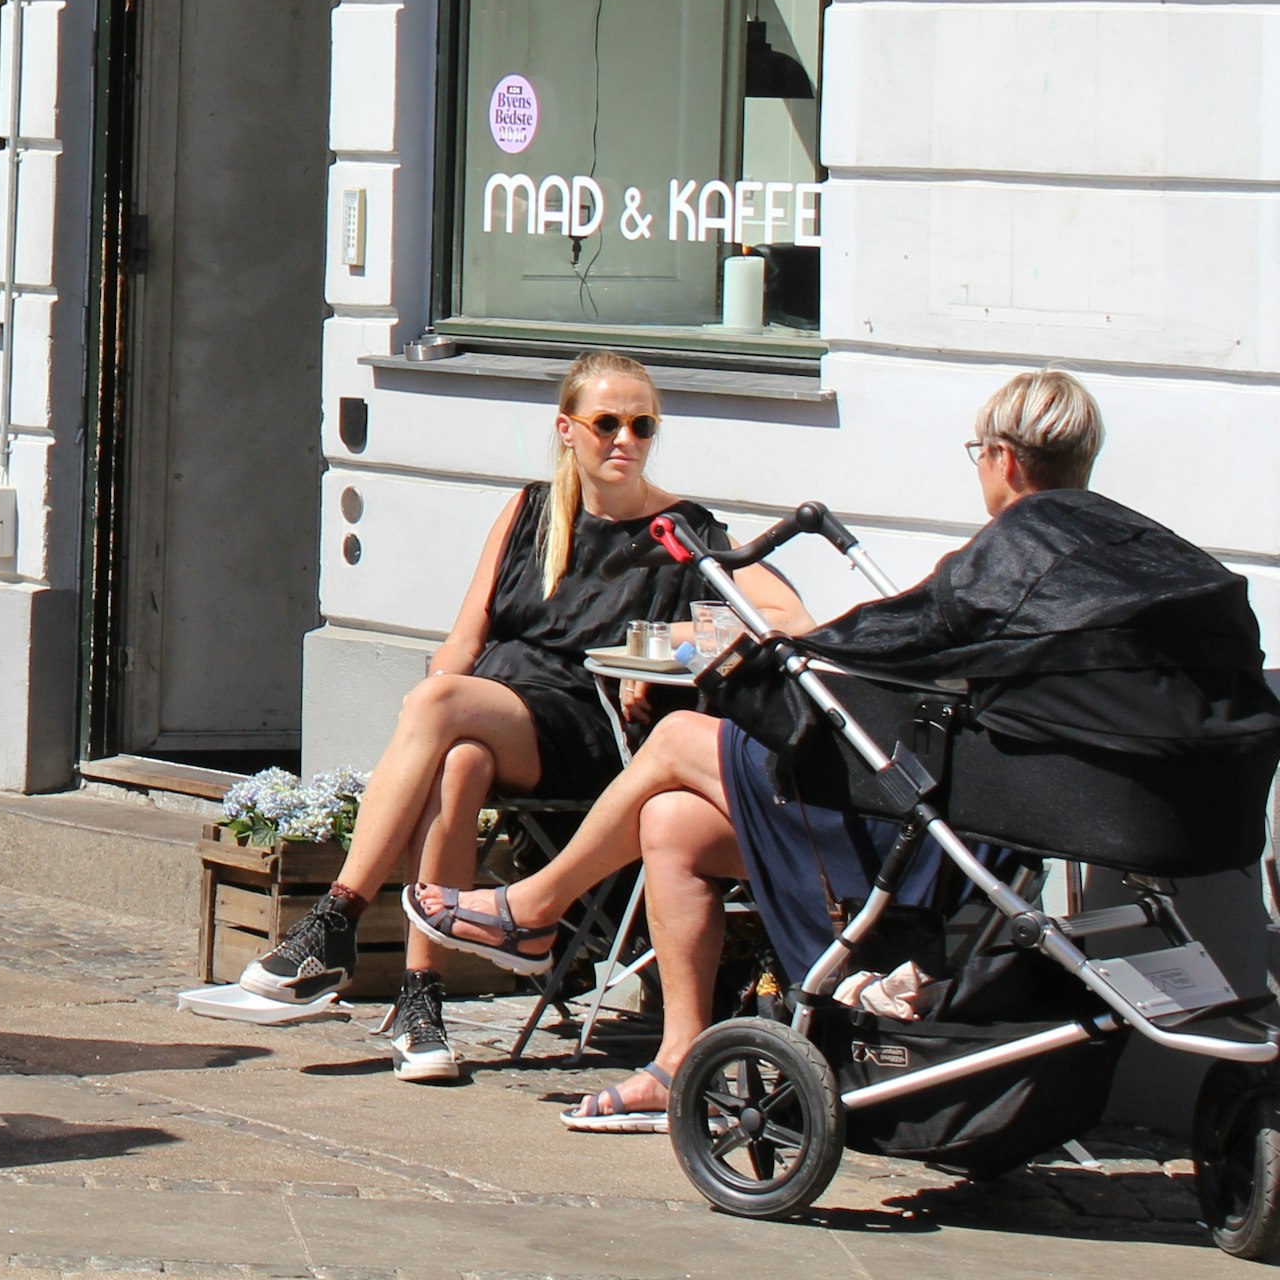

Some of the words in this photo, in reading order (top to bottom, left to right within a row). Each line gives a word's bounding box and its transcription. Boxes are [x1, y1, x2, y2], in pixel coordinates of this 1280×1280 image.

[498, 93, 531, 111] Byens
[495, 110, 533, 125] Bedste
[482, 173, 604, 238] MAD
[619, 186, 653, 241] &
[668, 178, 822, 248] KAFFE
